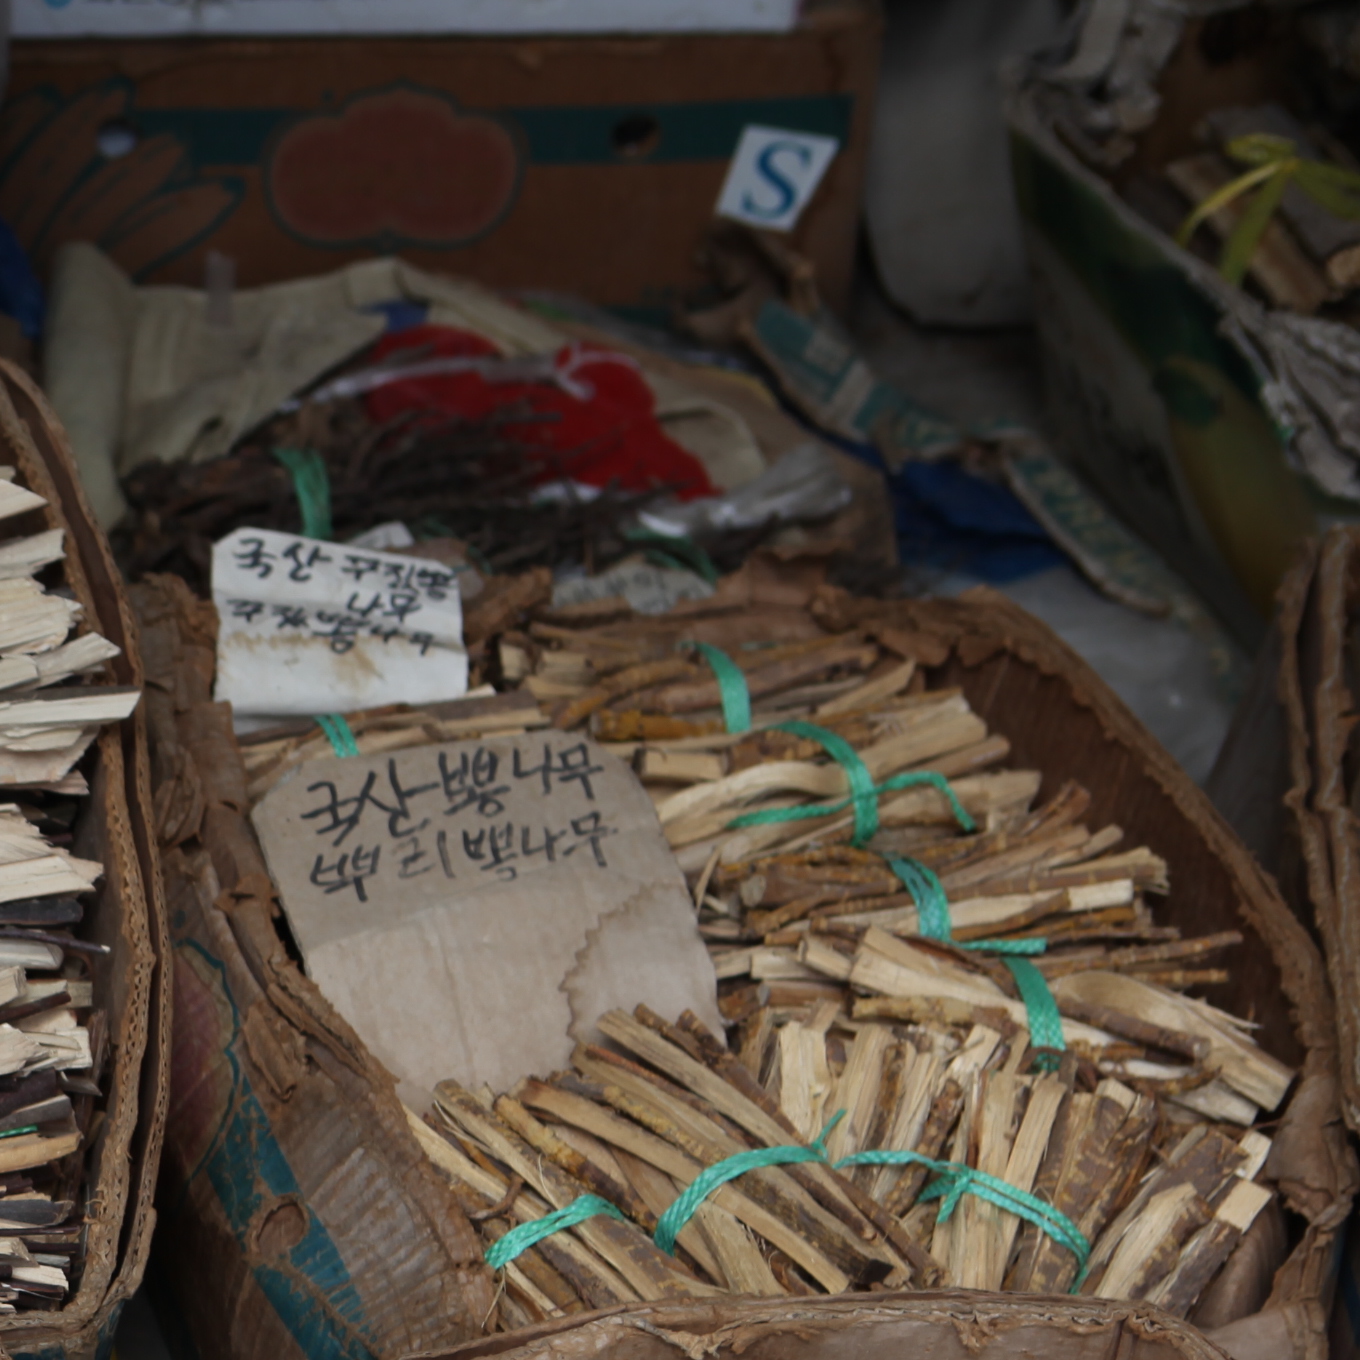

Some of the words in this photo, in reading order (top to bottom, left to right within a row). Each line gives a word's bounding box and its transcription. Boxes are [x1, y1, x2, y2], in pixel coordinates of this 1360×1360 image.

[742, 140, 811, 219] S
[232, 537, 332, 583] 국산
[301, 757, 440, 847] 국산
